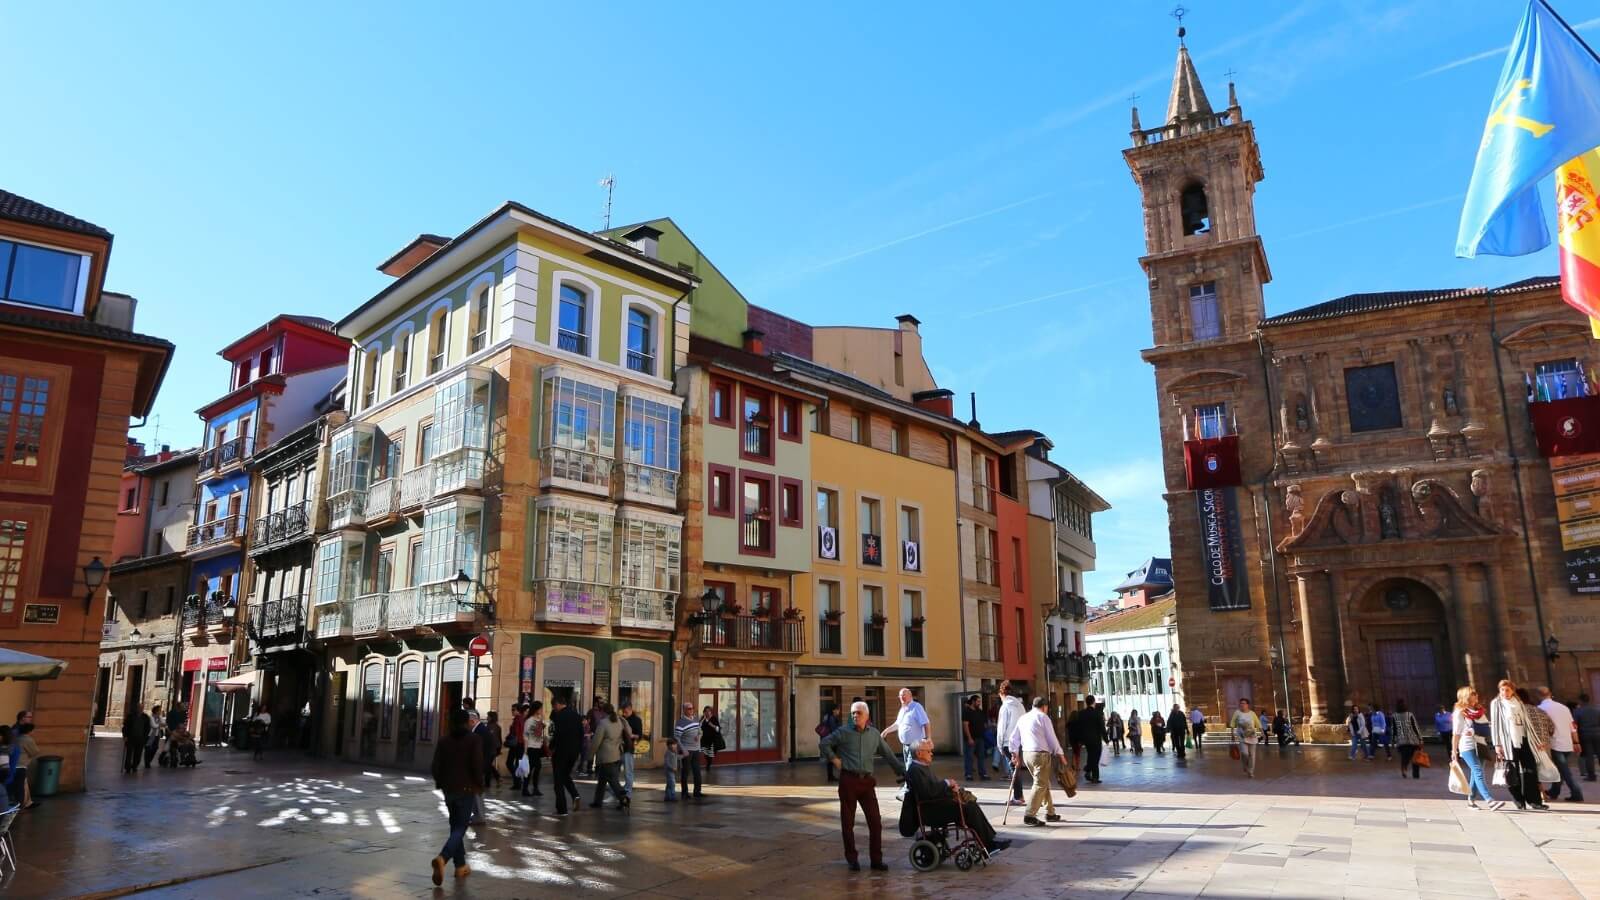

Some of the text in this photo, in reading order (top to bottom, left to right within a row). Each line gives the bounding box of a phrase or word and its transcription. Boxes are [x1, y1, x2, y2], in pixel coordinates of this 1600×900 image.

[1204, 489, 1215, 512] SACR
[1210, 547, 1221, 559] DE
[1211, 560, 1224, 585] CICLO
